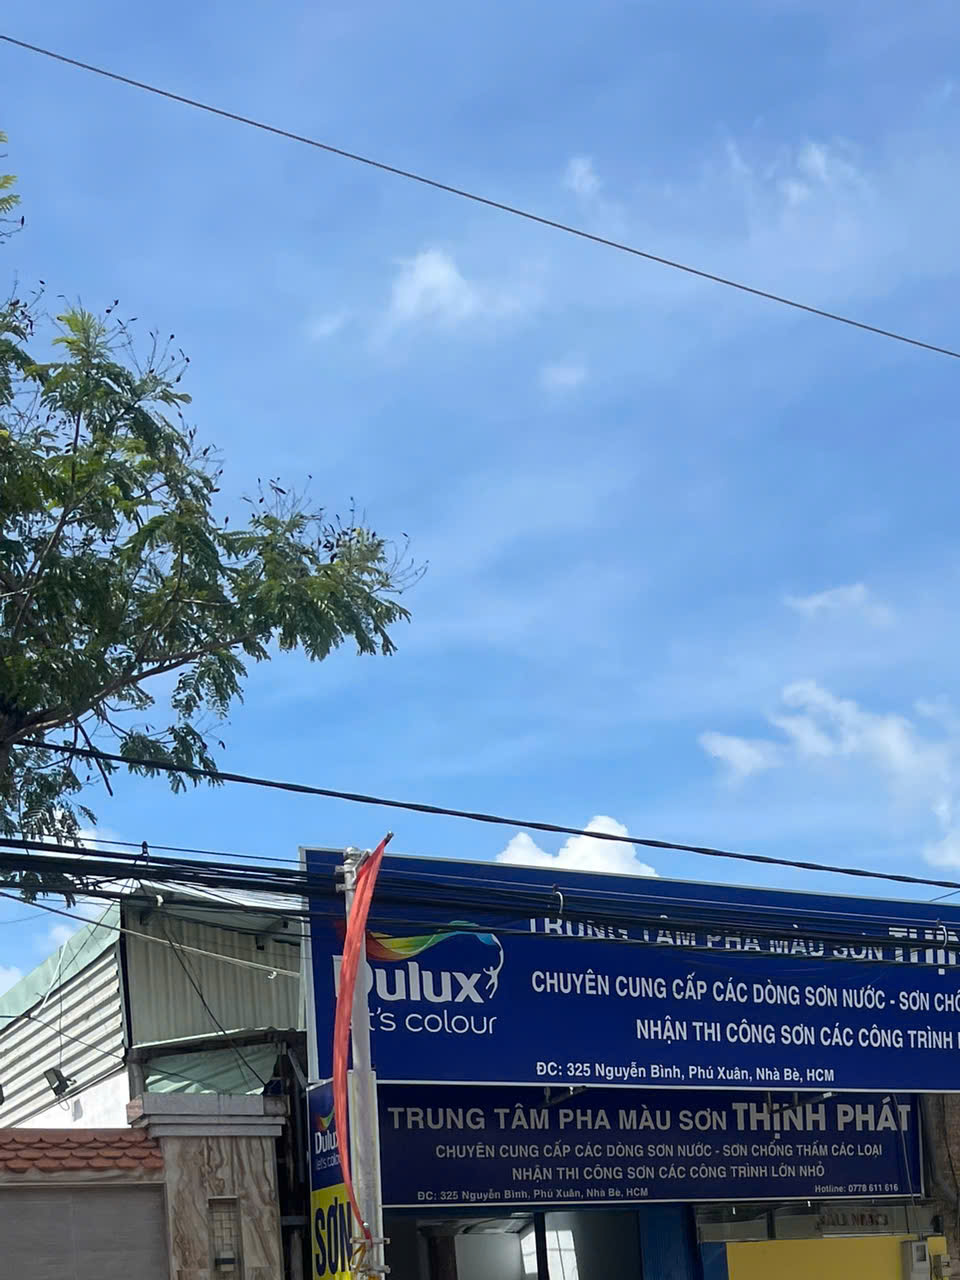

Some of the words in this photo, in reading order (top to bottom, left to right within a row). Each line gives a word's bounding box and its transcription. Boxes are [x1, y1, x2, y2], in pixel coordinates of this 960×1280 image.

[532, 969, 609, 995] CHUYÊN
[615, 976, 667, 999] CUNG
[672, 972, 707, 1000] CẤP
[712, 977, 748, 1003] CÁC
[753, 980, 800, 1006] DÒNG
[805, 985, 837, 1008] SƠN
[842, 985, 885, 1009] NƯỚC
[900, 990, 930, 1012] SƠN
[405, 1009, 497, 1034] colour
[636, 1015, 687, 1044] NHẬN
[692, 1022, 721, 1042] THI
[726, 1019, 775, 1044] CÔNG
[781, 1024, 815, 1046] SƠN
[820, 1023, 853, 1047] CÁC
[858, 1024, 903, 1048] CÔNG
[907, 1026, 952, 1049] TRÌNH
[536, 1062, 562, 1076] ĐC:
[567, 1063, 591, 1077] 325
[595, 1062, 646, 1080] Nguyễn
[650, 1064, 684, 1080] Bình,
[688, 1065, 714, 1079] Phú
[717, 1066, 752, 1081] Xuân,
[756, 1067, 780, 1081] Nhà
[784, 1068, 803, 1083] Bè,
[807, 1069, 834, 1082] HCM
[388, 1107, 485, 1130] TRUNG
[494, 1103, 549, 1130] TÂM
[559, 1107, 611, 1130] PHA
[618, 1104, 671, 1130] MÀU
[679, 1107, 727, 1131] SƠN
[732, 1102, 827, 1139] THỊNH
[837, 1096, 911, 1131] PHÁT
[435, 1142, 495, 1158] CHUYÊN
[500, 1144, 539, 1158] CUNG
[543, 1140, 571, 1158] CẤP
[575, 1142, 602, 1158] CÁC
[607, 1142, 644, 1158] DÒNG
[648, 1144, 674, 1158] SƠN
[677, 1141, 712, 1157] NƯỚC
[723, 1143, 748, 1157] SƠN
[751, 1140, 793, 1156] CHỐNG
[796, 1140, 828, 1156] THẤM
[831, 1141, 855, 1156] CÁC
[858, 1144, 882, 1158] LOẠI
[512, 1165, 552, 1183] NHẬN
[557, 1167, 579, 1180] THI
[583, 1164, 623, 1180] CÔNG
[627, 1165, 655, 1179] SƠN
[659, 1163, 686, 1179] CÁC
[690, 1162, 727, 1178] CÔNG
[731, 1162, 767, 1178] TRÌNH
[771, 1162, 795, 1177] LỚN
[799, 1161, 825, 1177] NHỎ
[417, 1191, 437, 1200] ĐC:
[440, 1191, 458, 1200] 325
[462, 1189, 500, 1202] Nguyễn
[533, 1188, 553, 1199] Phú
[586, 1188, 605, 1198] Nhà
[626, 1187, 648, 1197] HCM
[815, 1185, 847, 1194] Hotline:
[848, 1184, 867, 1193] 0778
[869, 1184, 883, 1193] 611
[884, 1184, 898, 1192] 616
